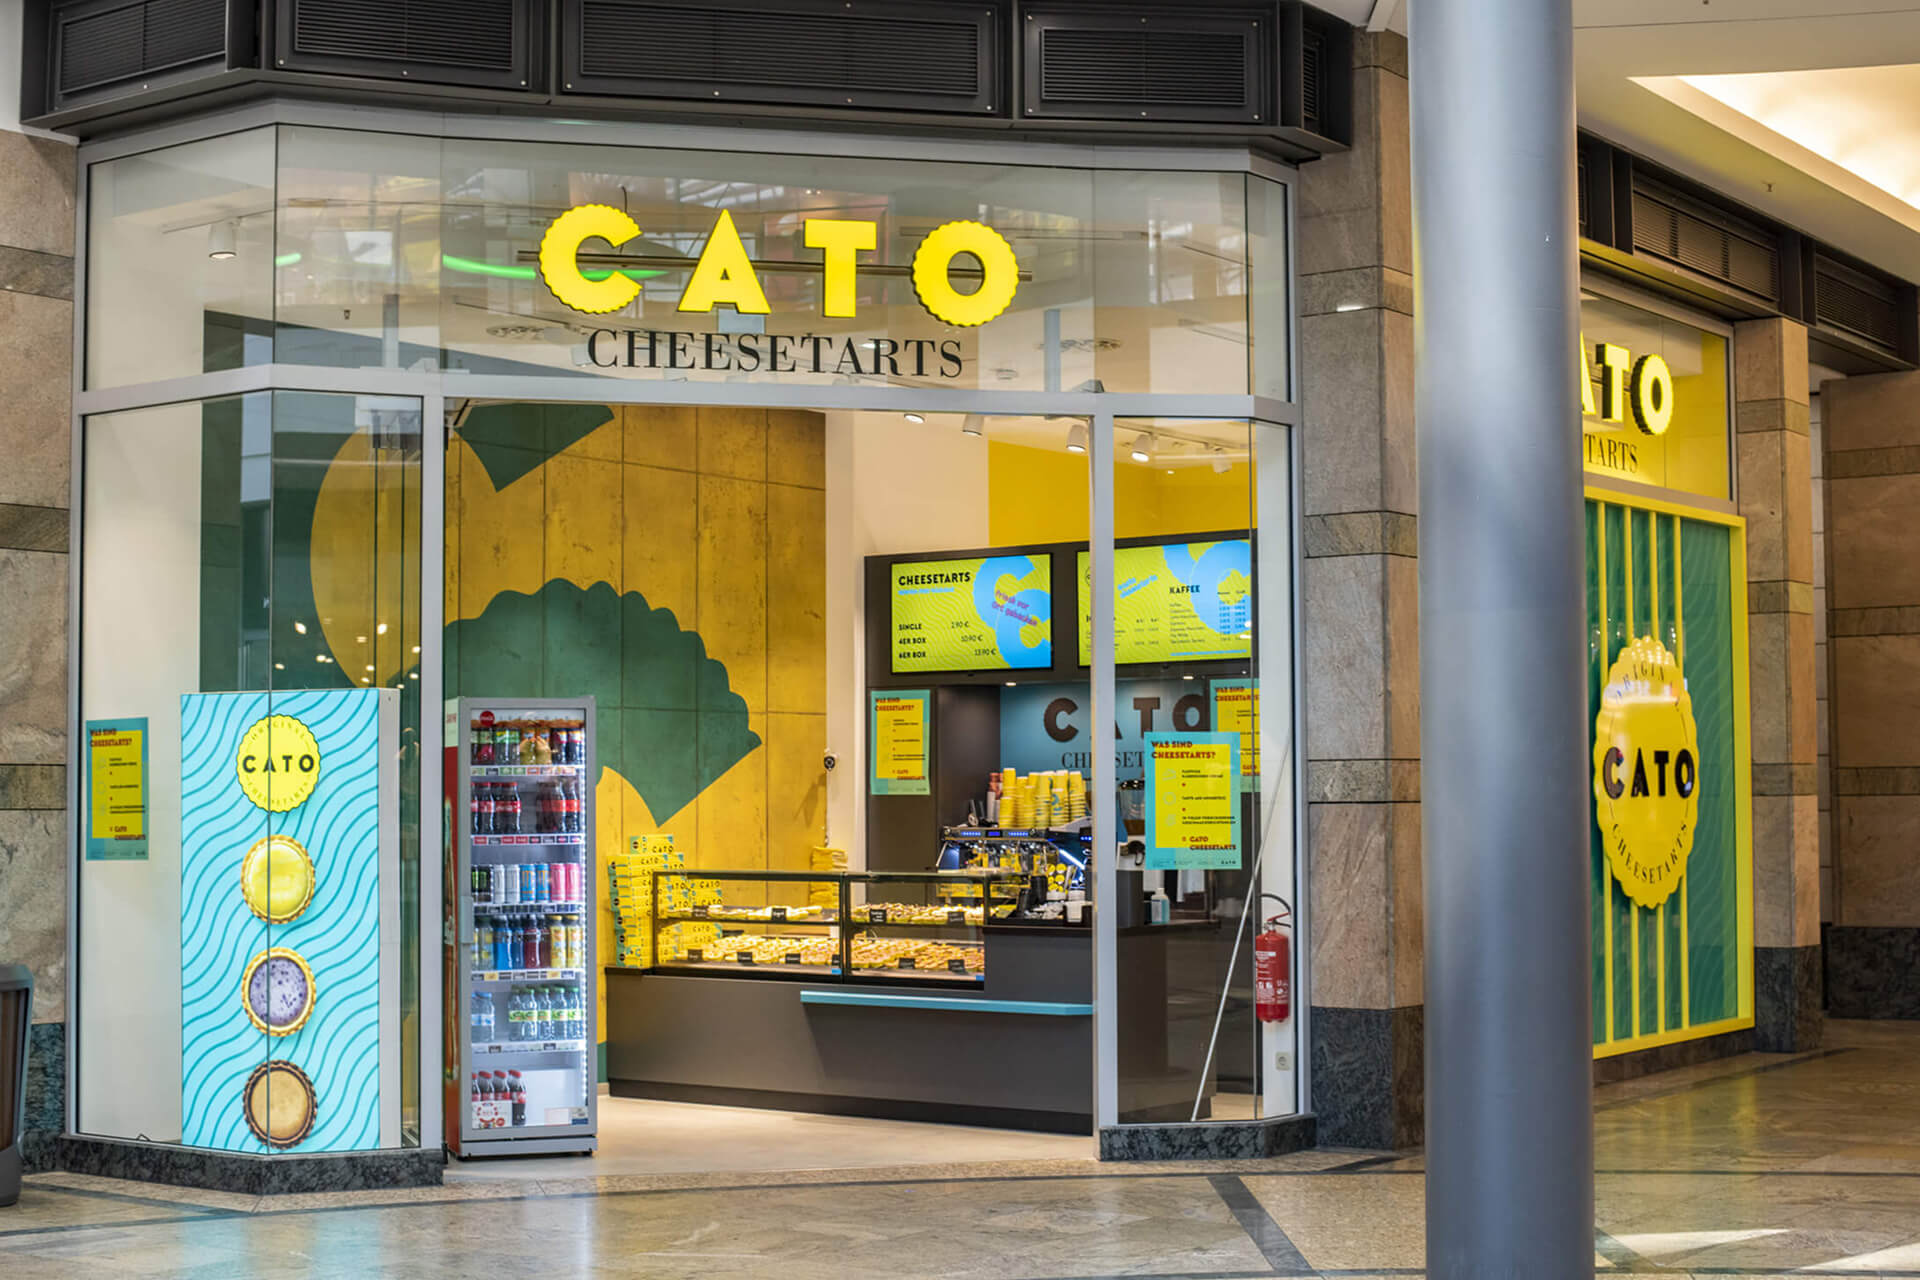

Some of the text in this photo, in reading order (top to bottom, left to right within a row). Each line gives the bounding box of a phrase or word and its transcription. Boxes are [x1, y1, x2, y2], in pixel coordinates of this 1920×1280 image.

[539, 203, 1020, 327] CATO
[587, 328, 963, 379] CHEESETARTS
[898, 572, 971, 586] CHEESETARTS
[1169, 585, 1200, 594] KAFFEE
[898, 623, 922, 631] SINGLE
[912, 637, 926, 645] BOX
[912, 651, 926, 659] BOX
[1043, 693, 1210, 743] CTO
[1151, 740, 1193, 749] WAS SIND
[1151, 751, 1216, 760] CHEESETARTS?
[242, 754, 315, 773] CATO
[1603, 747, 1696, 800] CATO
[1612, 822, 1688, 884] CHEESETARTS
[641, 857, 659, 865] CATO
[700, 881, 720, 889] CATO
